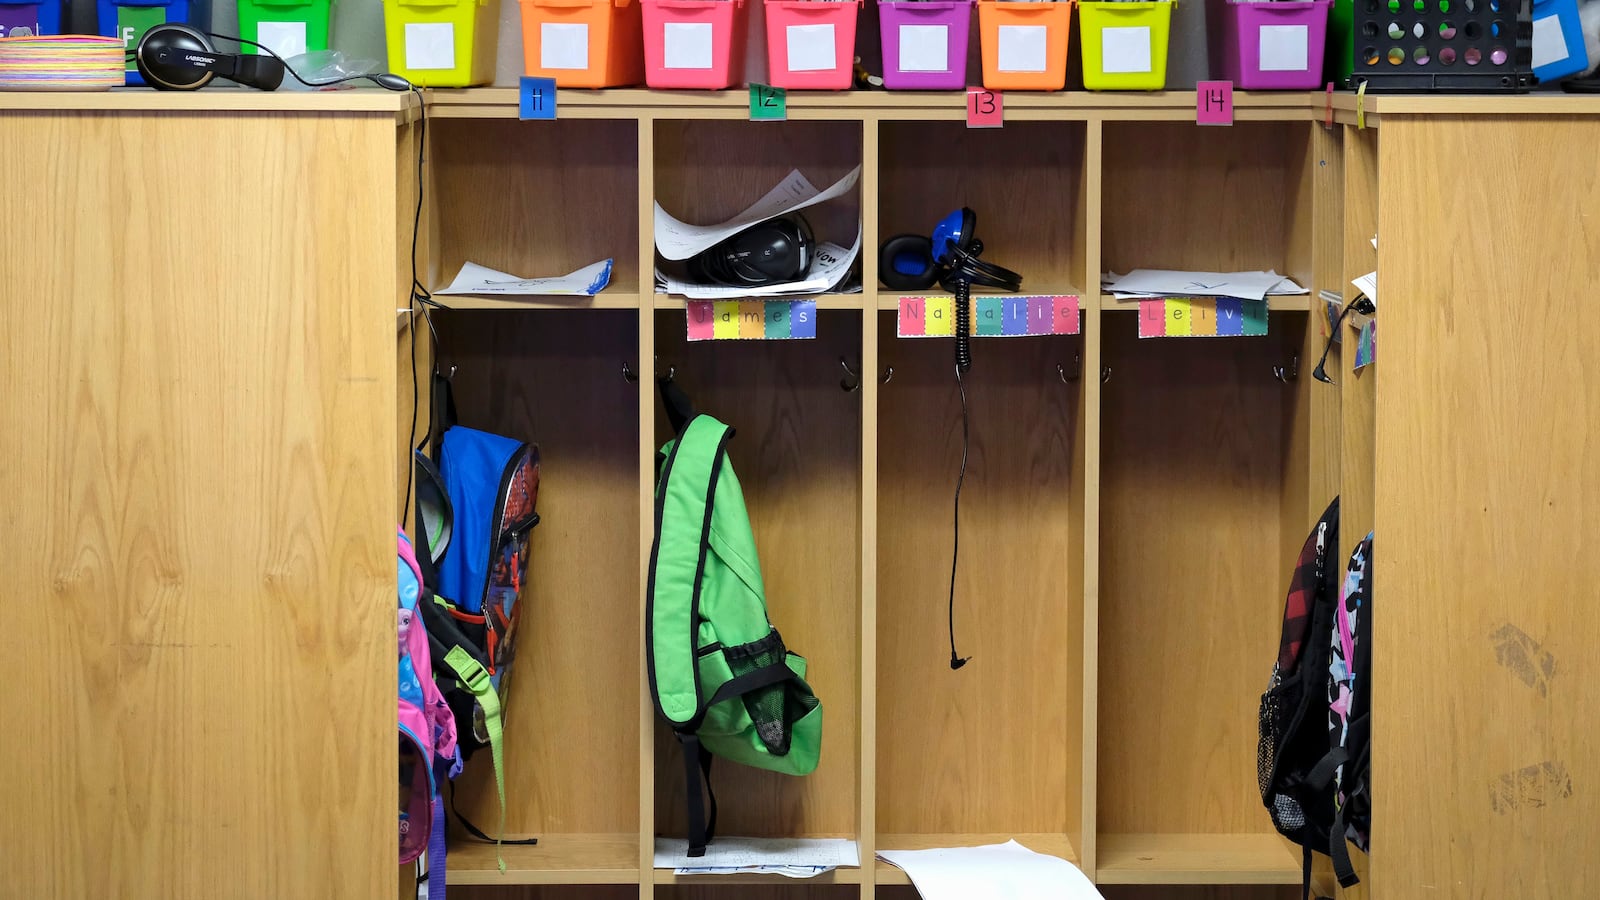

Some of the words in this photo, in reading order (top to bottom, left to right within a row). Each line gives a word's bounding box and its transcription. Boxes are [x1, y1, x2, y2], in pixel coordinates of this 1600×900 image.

[122, 27, 135, 47] F
[757, 86, 779, 107] 12
[974, 91, 996, 114] 13
[1206, 88, 1225, 112] 14
[696, 306, 808, 323] James
[906, 302, 1071, 319] Naalie
